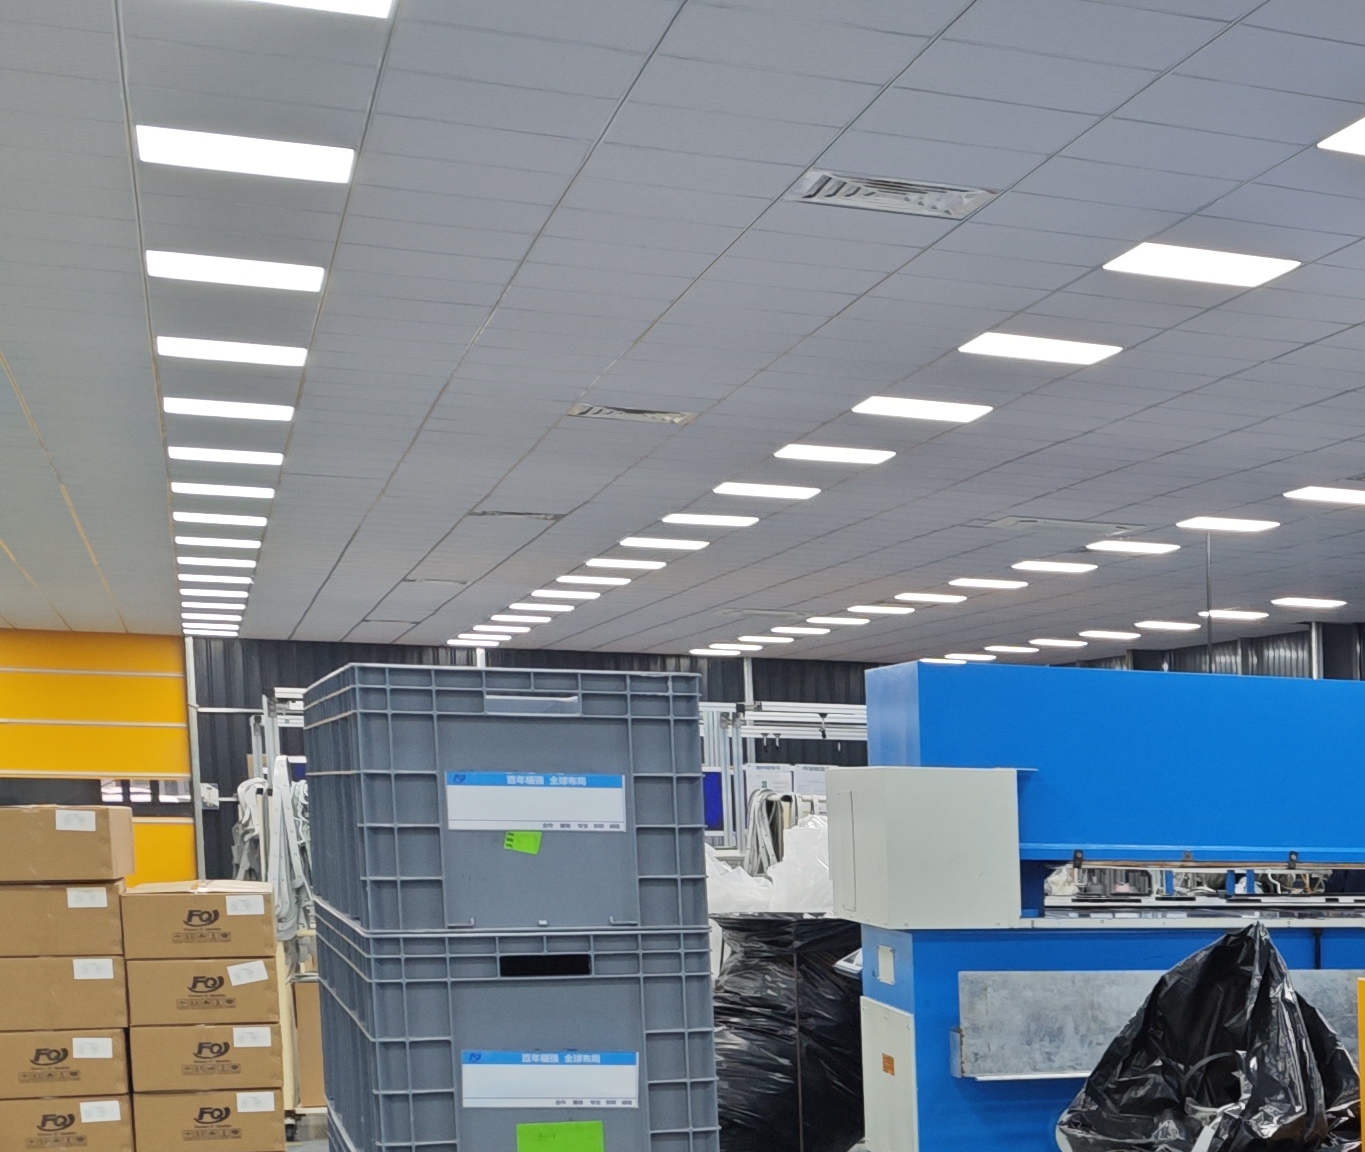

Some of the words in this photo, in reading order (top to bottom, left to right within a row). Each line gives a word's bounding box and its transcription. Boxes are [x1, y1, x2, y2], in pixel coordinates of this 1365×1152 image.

[185, 909, 216, 926] FQ
[189, 976, 221, 992] FQ
[32, 1048, 65, 1065] FQ
[195, 1042, 227, 1058] FQ
[39, 1114, 72, 1131] FQ
[196, 1107, 228, 1123] FQ
